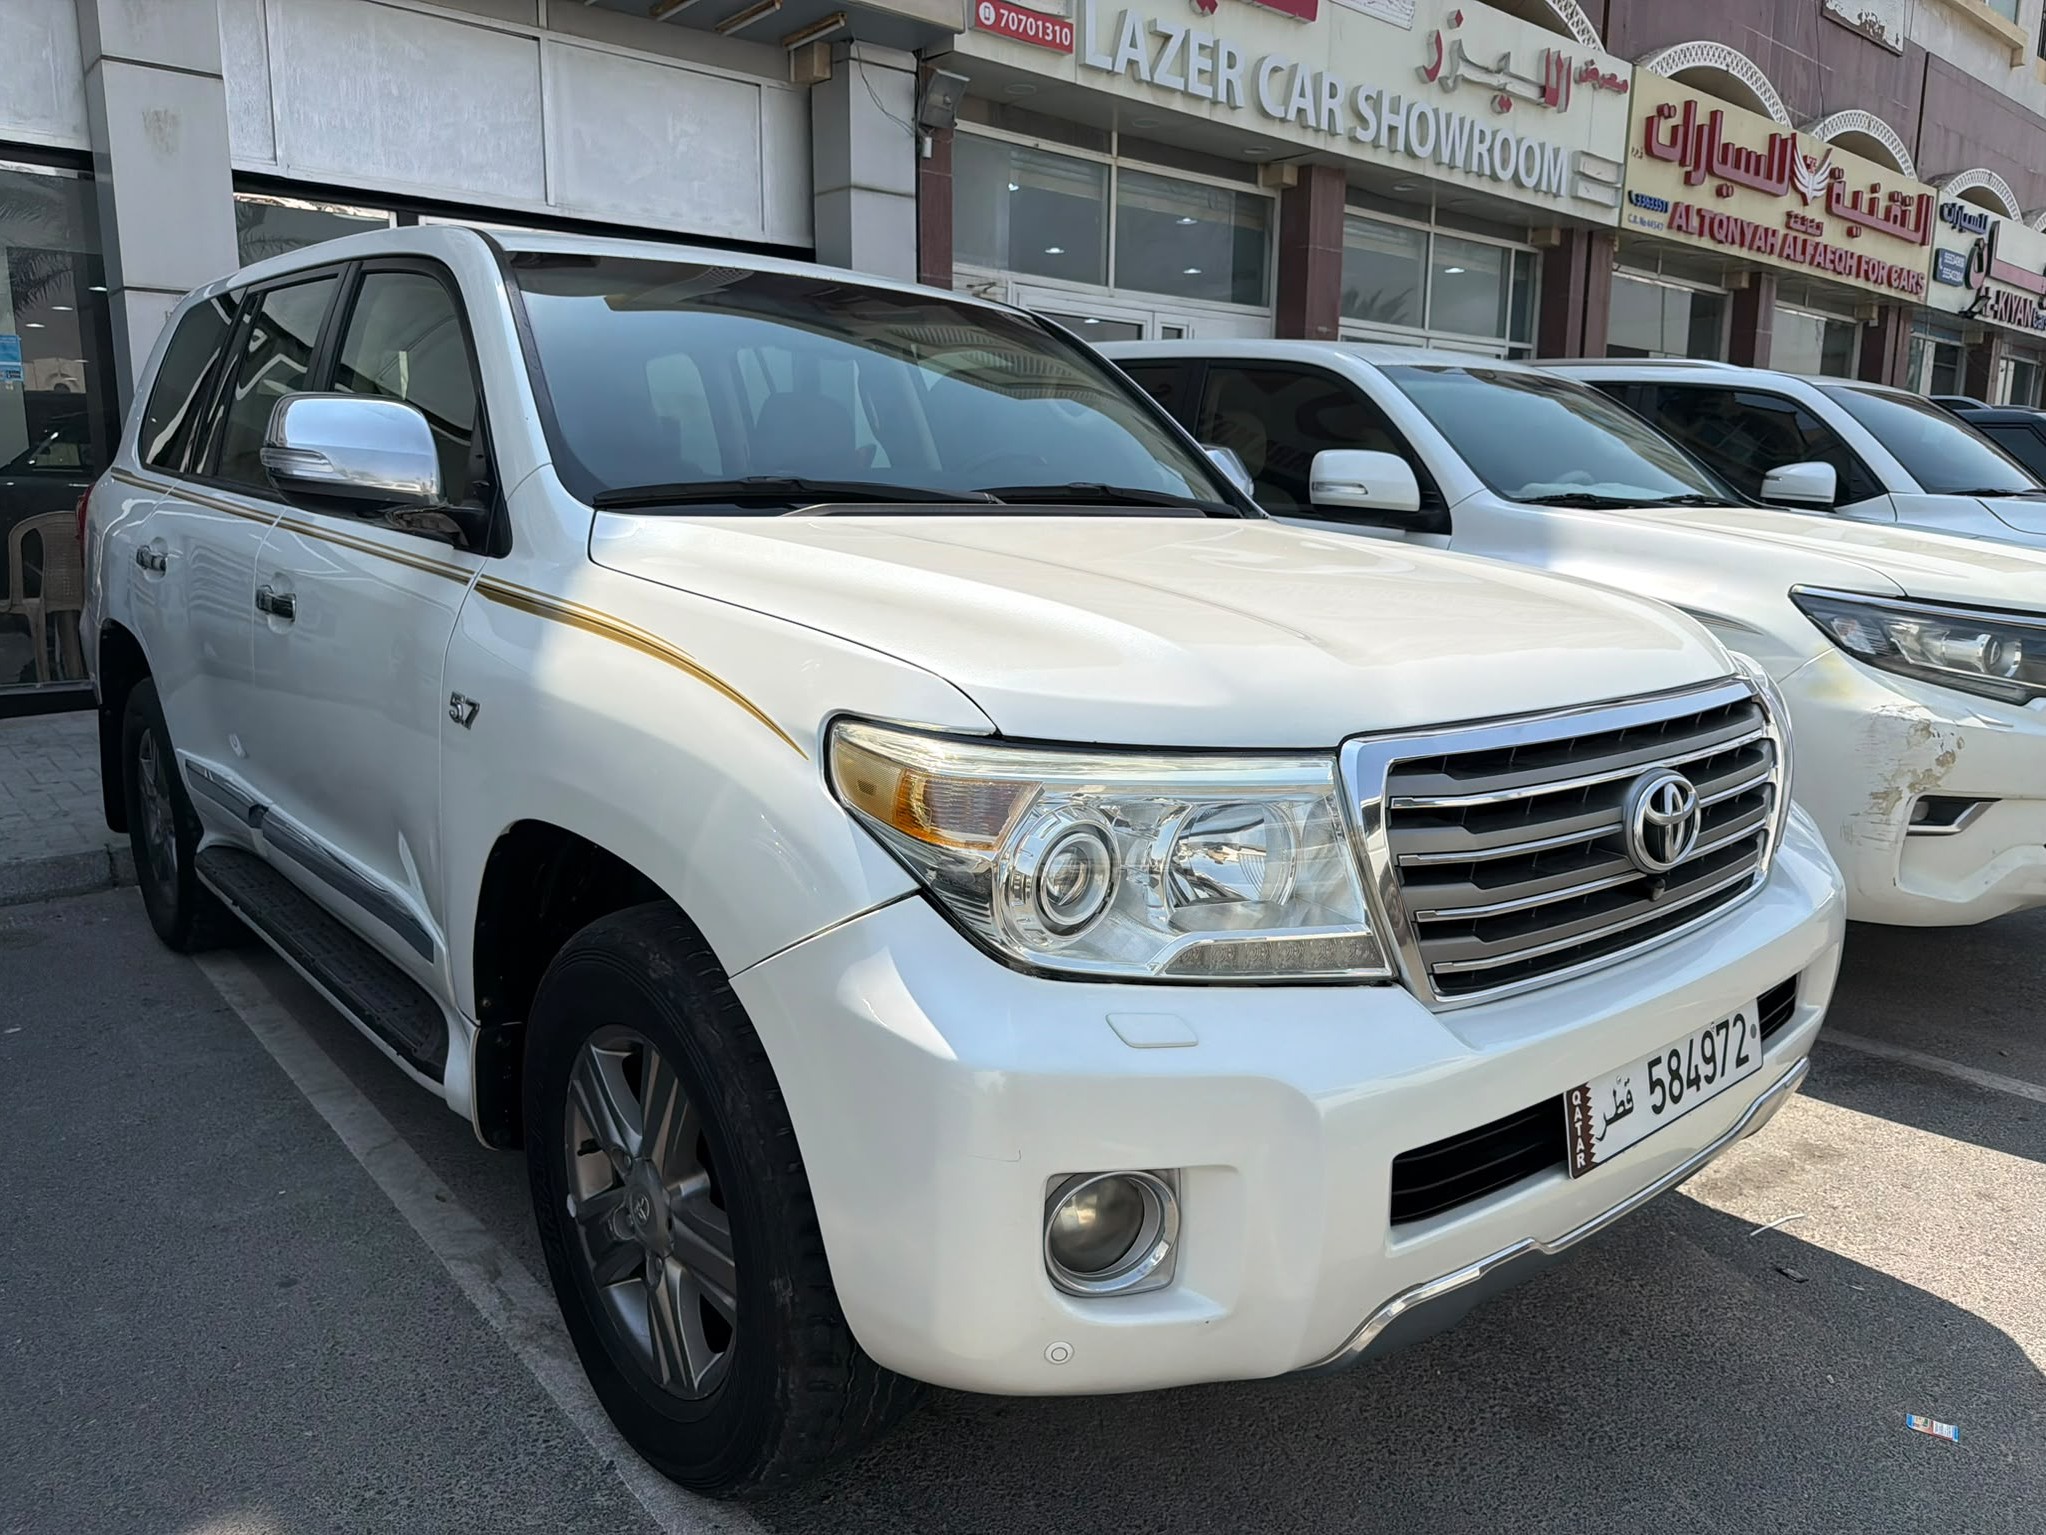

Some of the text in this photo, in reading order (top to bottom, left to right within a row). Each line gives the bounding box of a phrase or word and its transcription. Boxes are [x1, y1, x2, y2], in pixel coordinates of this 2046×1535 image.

[1000, 9, 1071, 46] 70701310
[1081, 0, 1568, 197] LAZER CAR SHOWROOM
[1826, 166, 1934, 247] التقنية
[1856, 255, 1888, 285] FOR
[1887, 265, 1926, 295] CARS
[1647, 1013, 1749, 1115] 584972
[1572, 1090, 1586, 1168] QATAR
[1595, 1077, 1634, 1142] قطر
